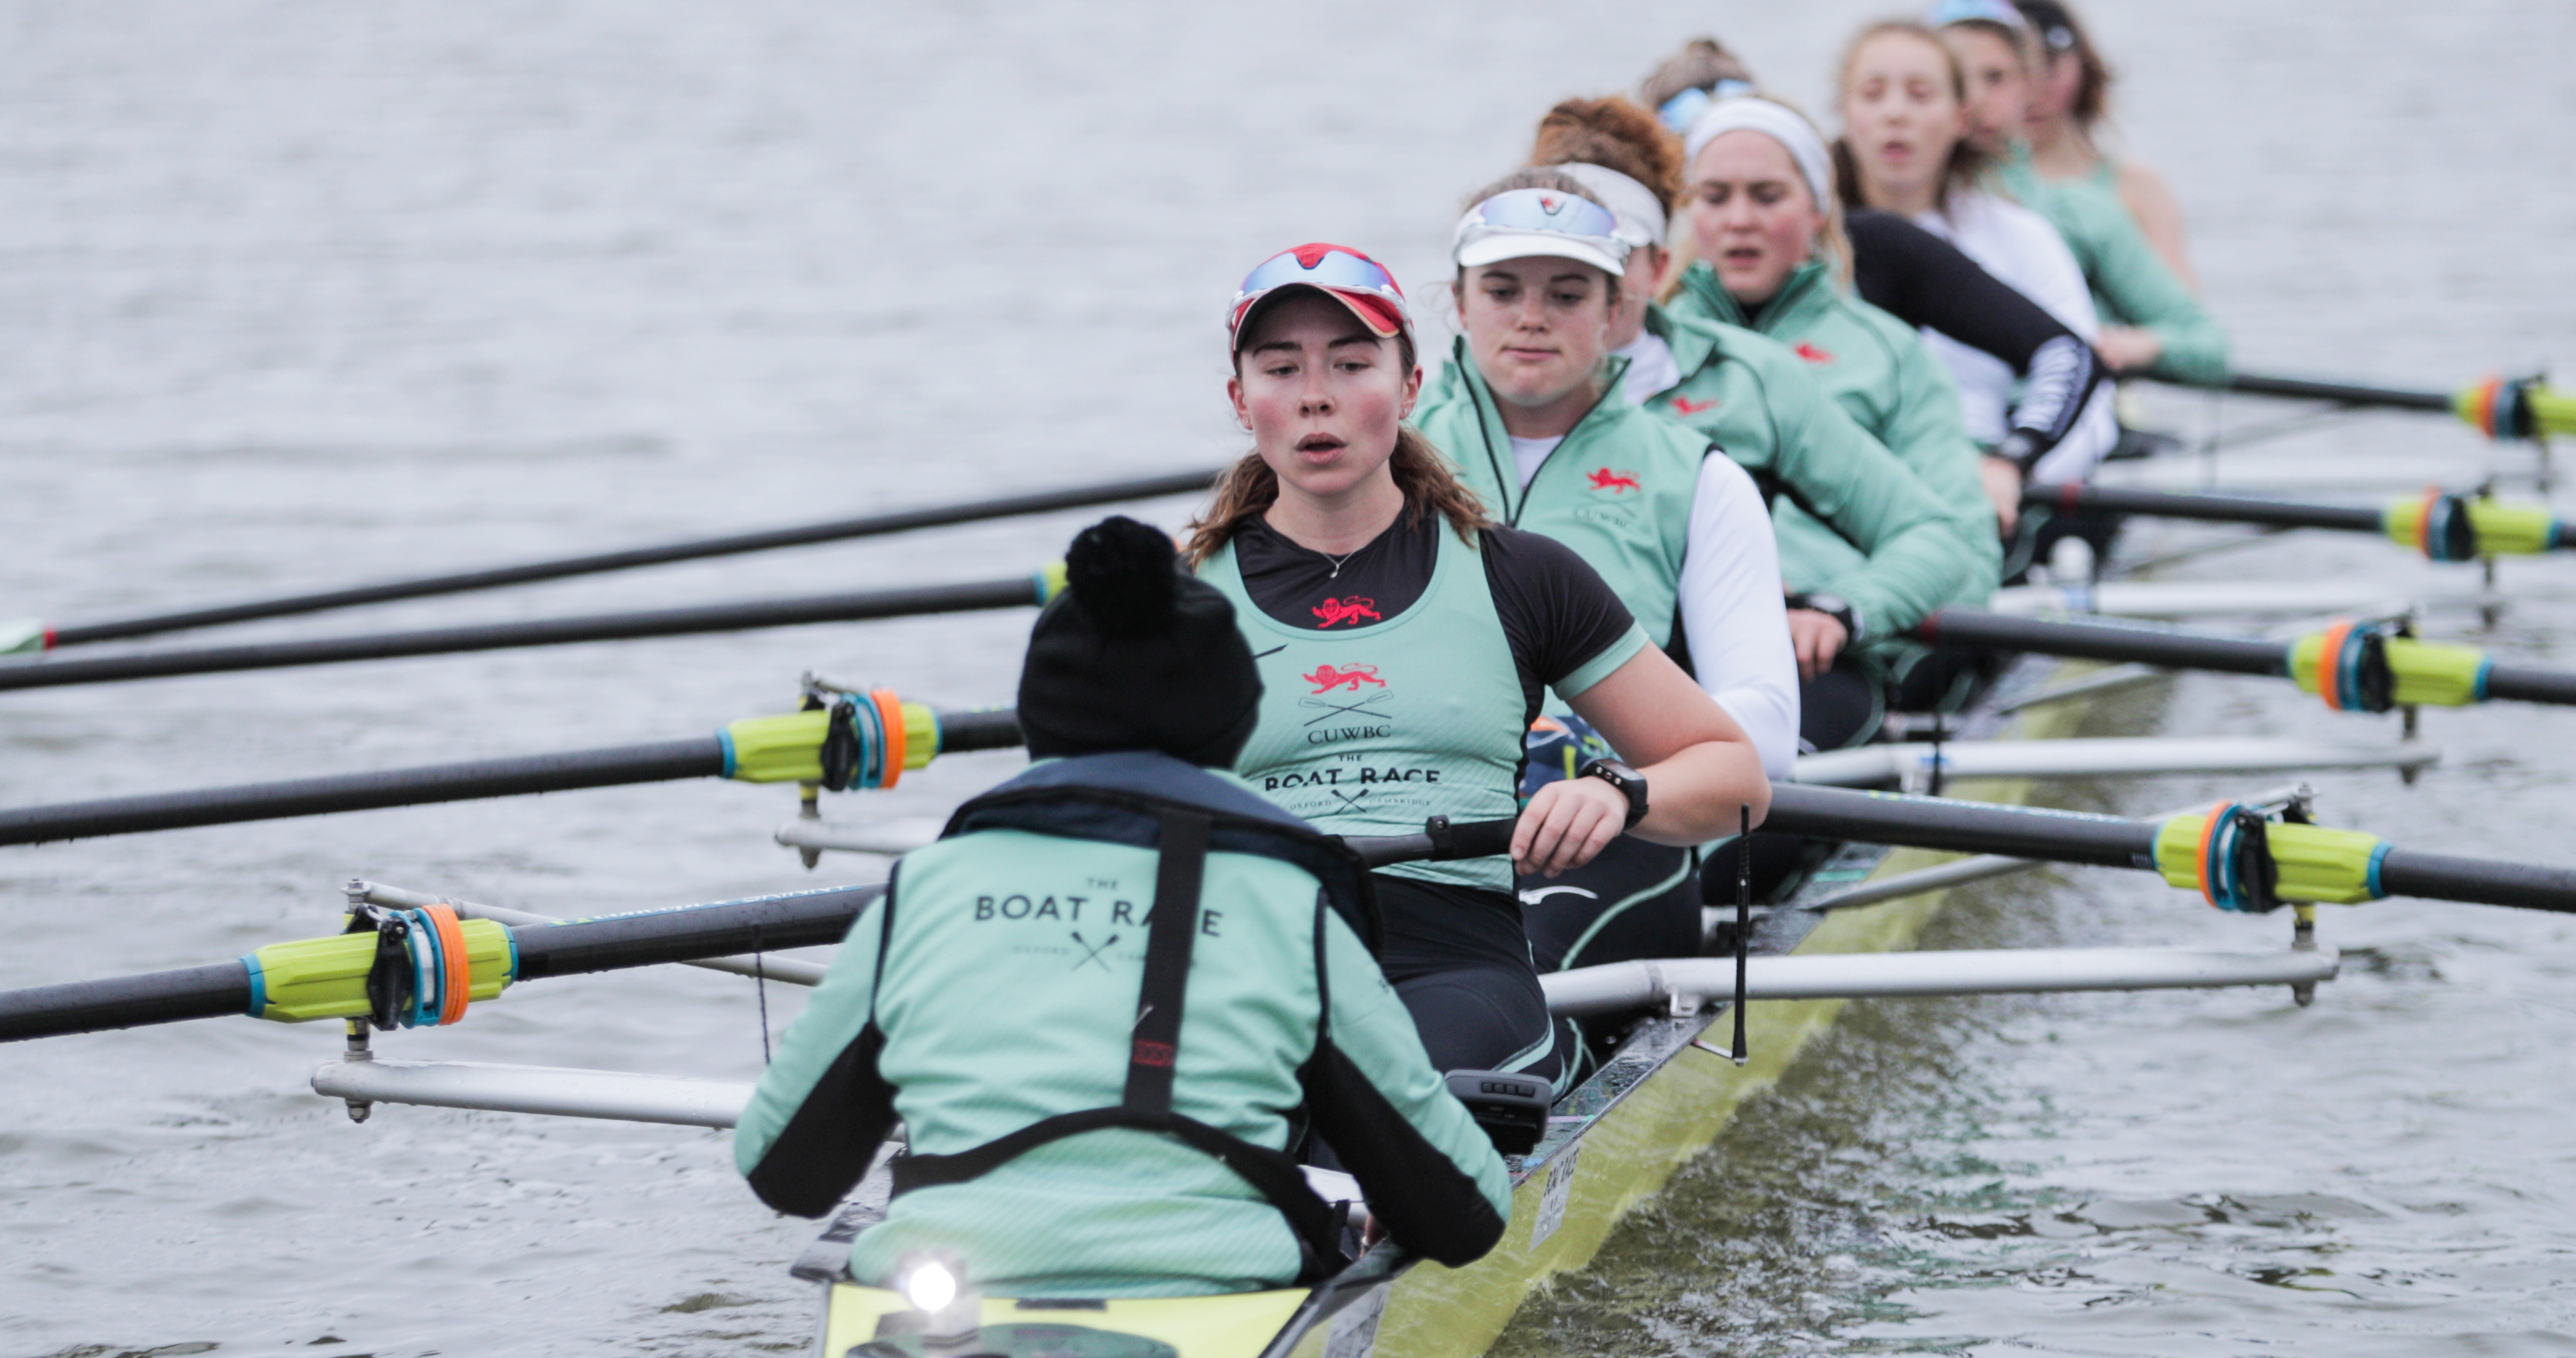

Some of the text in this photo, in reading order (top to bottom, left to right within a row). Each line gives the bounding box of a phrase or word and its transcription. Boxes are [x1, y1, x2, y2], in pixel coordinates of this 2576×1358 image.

[1308, 725, 1391, 744] CUWBC
[1265, 767, 1441, 792] BOAT RACE
[1290, 800, 1332, 810] OXFORD
[975, 894, 1223, 937] BOAT RE
